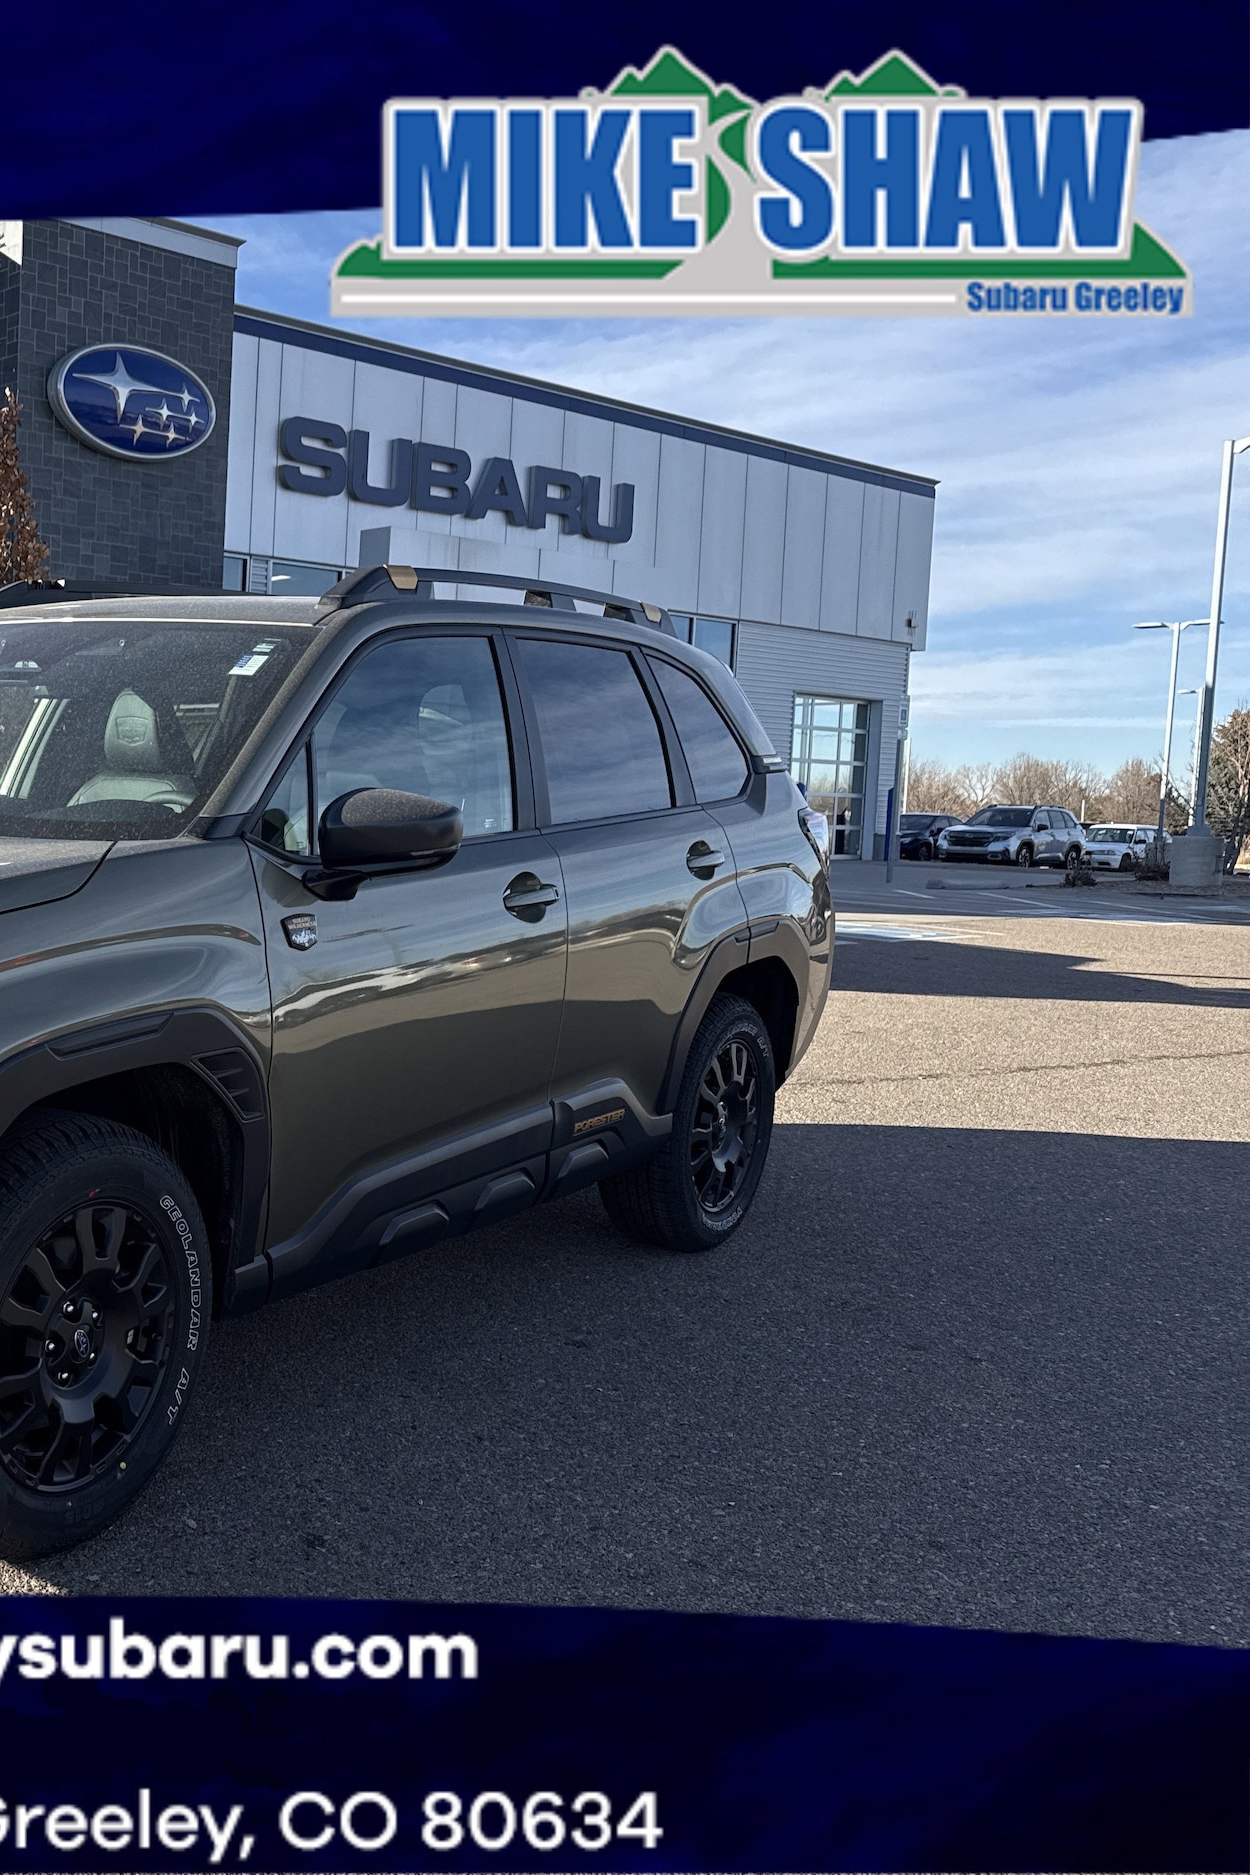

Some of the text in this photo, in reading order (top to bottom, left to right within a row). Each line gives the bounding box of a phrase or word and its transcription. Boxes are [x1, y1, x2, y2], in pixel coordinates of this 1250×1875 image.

[278, 414, 635, 544] SUBARU
[573, 1108, 626, 1134] FORESTER
[159, 1194, 202, 1351] GEOLANDAR
